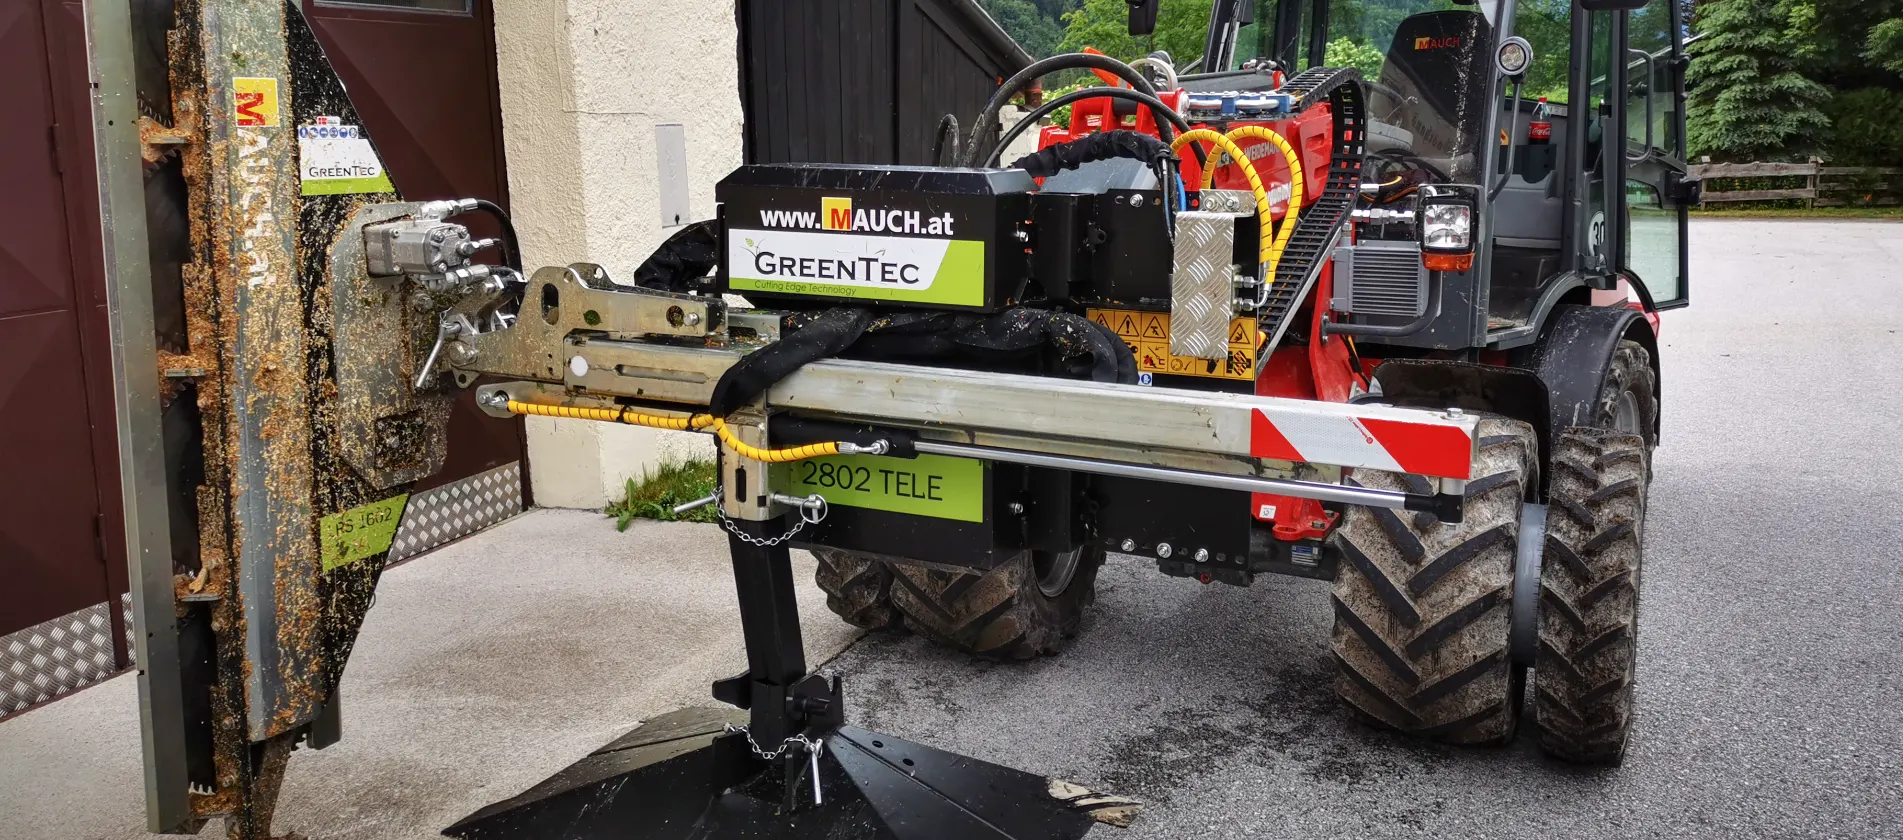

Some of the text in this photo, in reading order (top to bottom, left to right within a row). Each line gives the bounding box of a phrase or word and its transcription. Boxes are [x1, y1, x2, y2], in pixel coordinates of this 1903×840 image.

[1418, 37, 1461, 50] MAUCH
[760, 207, 955, 235] www.MAUCH.at
[754, 279, 857, 297] Cutting Edge Technology
[802, 460, 943, 502] 2802 TELE
